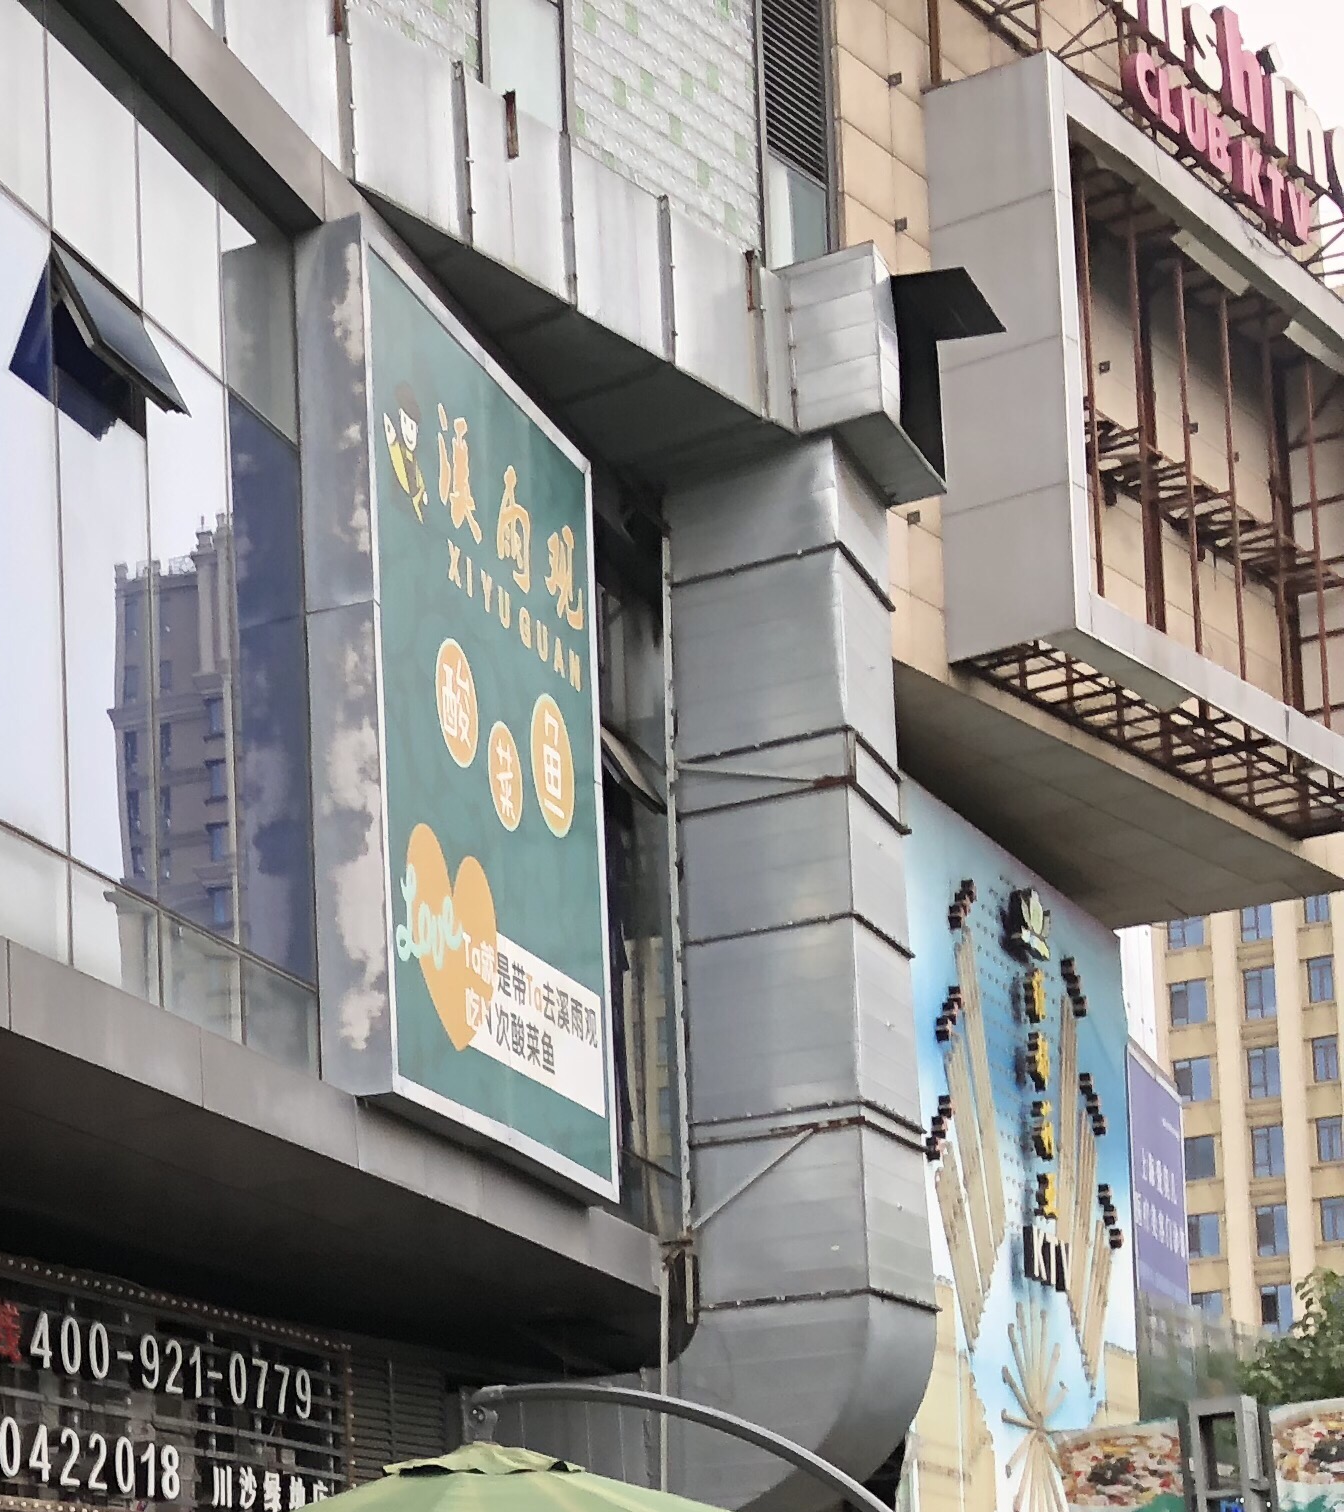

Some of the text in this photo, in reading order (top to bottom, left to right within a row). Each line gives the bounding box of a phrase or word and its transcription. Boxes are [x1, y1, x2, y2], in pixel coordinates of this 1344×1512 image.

[1135, 52, 1311, 245] CLUB KTV
[436, 402, 585, 631] 溪雨观
[447, 538, 582, 691] XIYUGUAN
[441, 658, 566, 822] 酸菜鱼
[395, 862, 464, 971] Love
[1032, 1223, 1073, 1292] KTV
[29, 1310, 313, 1421] 400-921-0779
